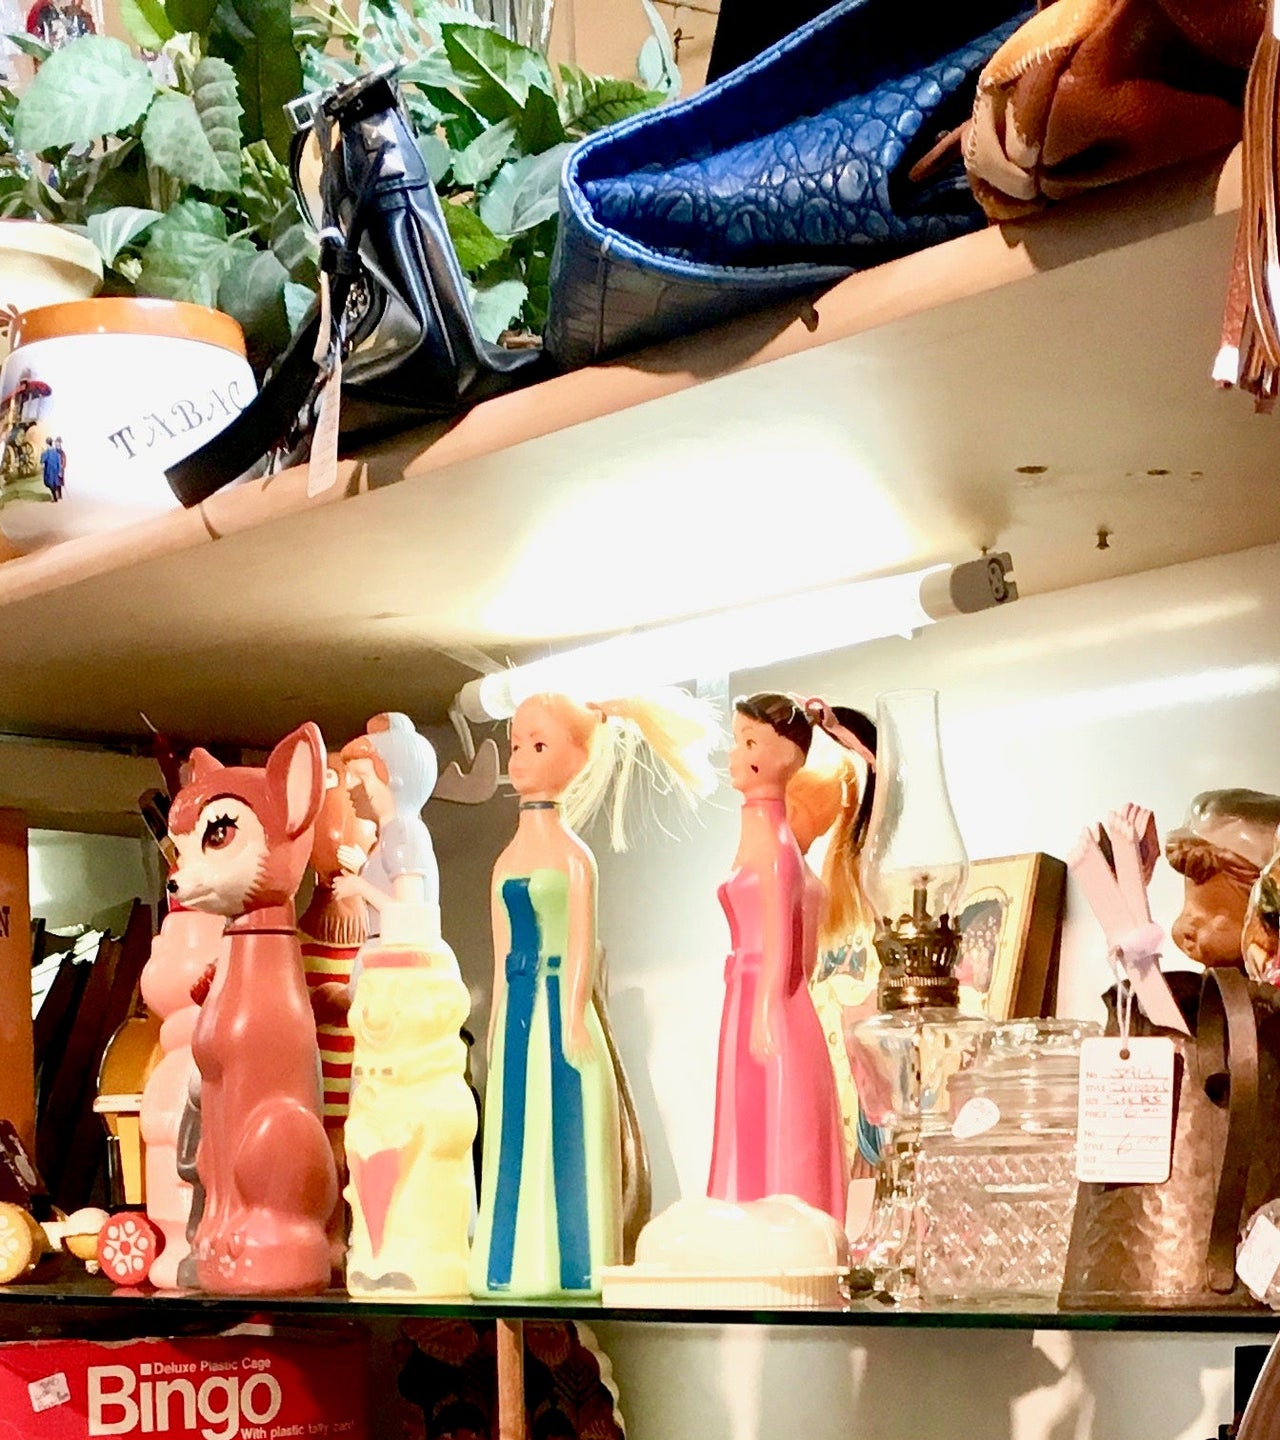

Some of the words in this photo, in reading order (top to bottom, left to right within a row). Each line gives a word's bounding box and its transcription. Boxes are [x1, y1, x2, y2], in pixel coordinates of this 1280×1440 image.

[154, 1362, 197, 1375] Deluxe
[200, 1359, 238, 1373] Plastic
[242, 1357, 271, 1371] Cage
[240, 1427, 267, 1440] With
[270, 1423, 305, 1440] plastic
